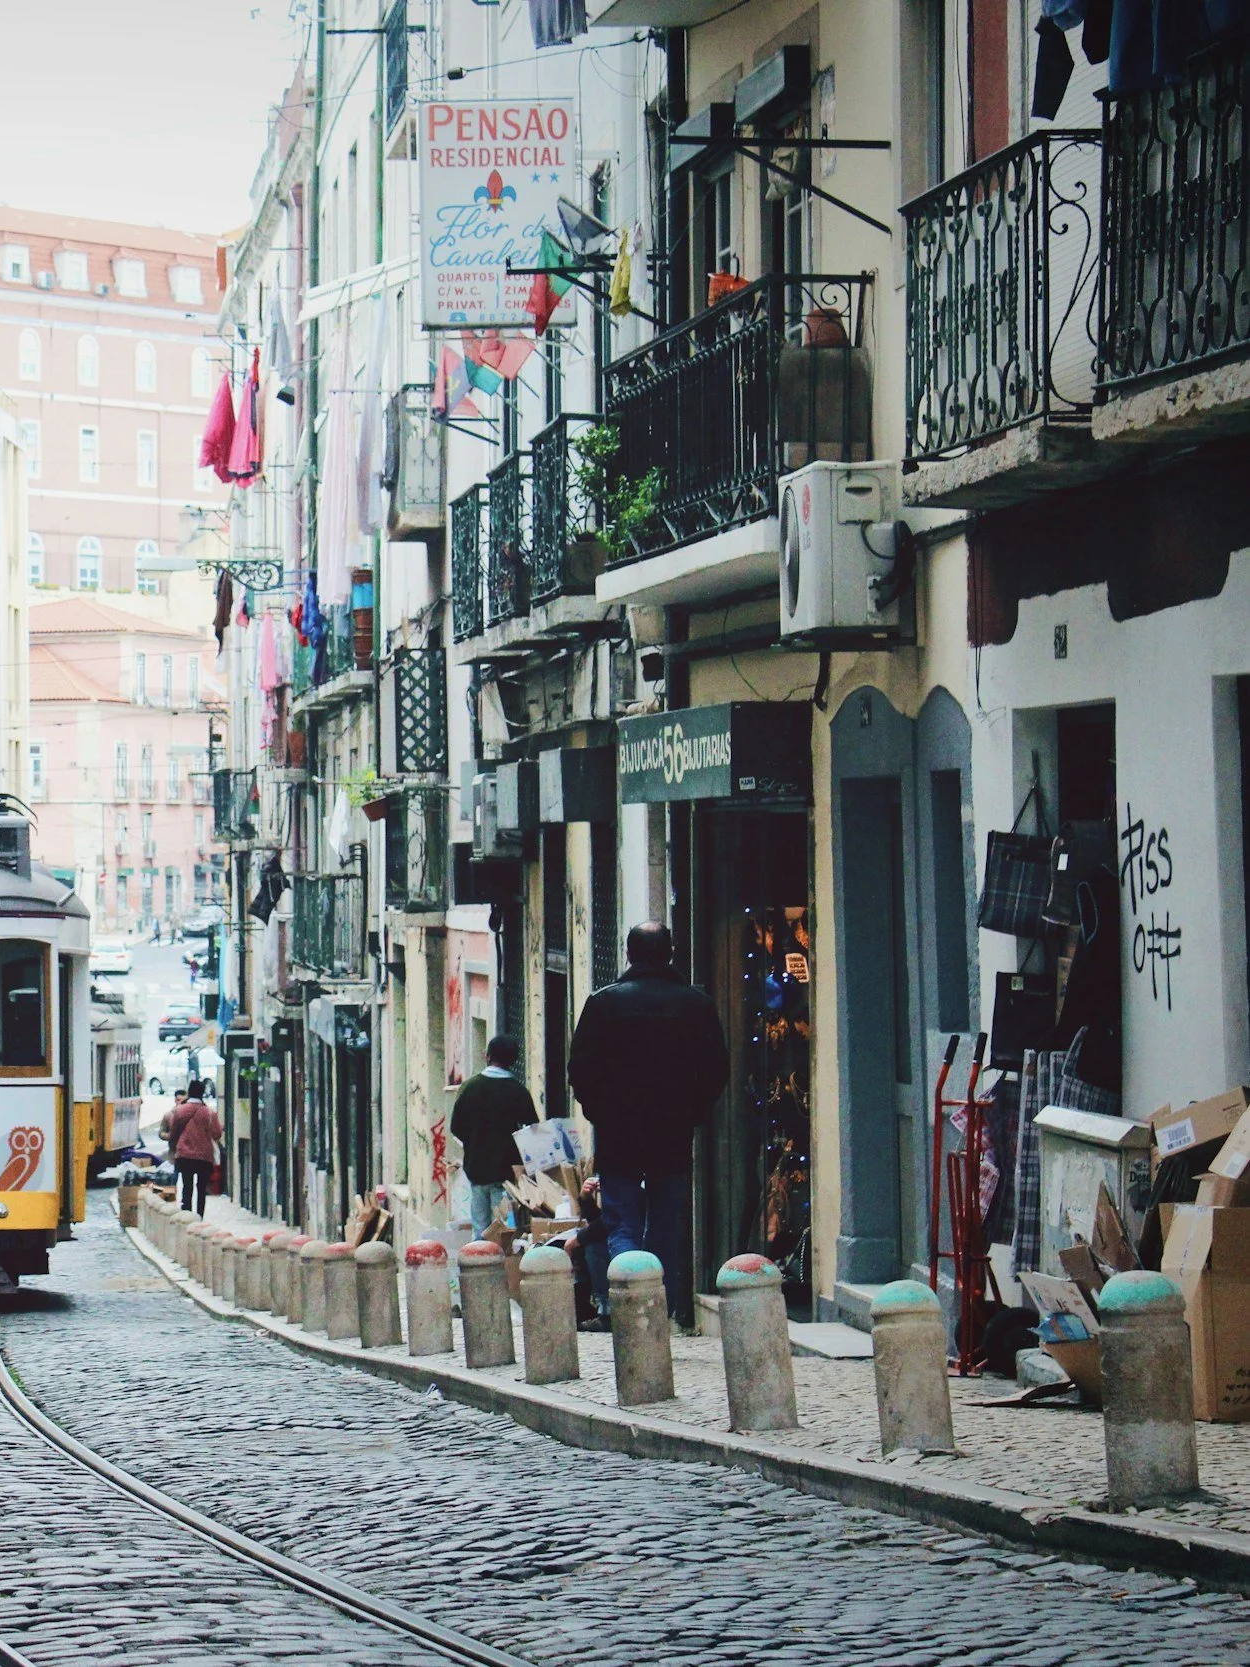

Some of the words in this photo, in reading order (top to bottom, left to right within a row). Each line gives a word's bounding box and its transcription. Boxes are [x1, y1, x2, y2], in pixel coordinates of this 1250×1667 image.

[430, 147, 565, 168] RESIDENCIAL
[438, 272, 495, 282] QUARTOS
[664, 723, 684, 784] 56
